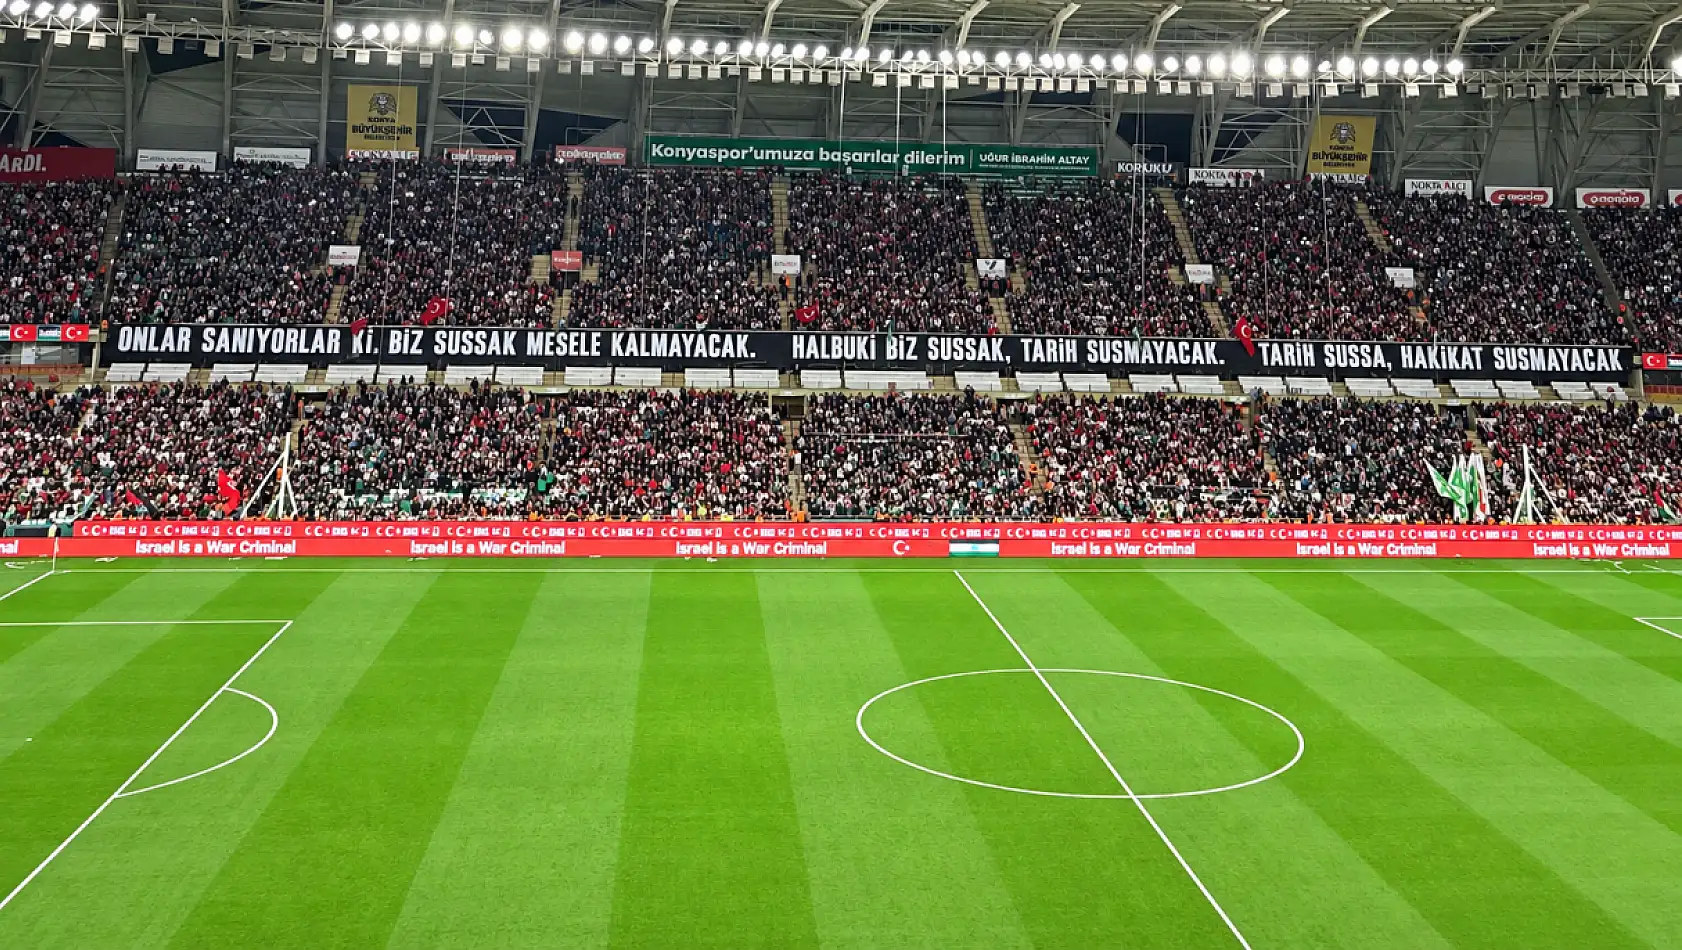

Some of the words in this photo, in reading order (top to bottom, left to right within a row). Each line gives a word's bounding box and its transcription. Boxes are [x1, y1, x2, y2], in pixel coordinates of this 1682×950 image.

[652, 143, 815, 163] Konyaspor'umuza
[819, 147, 900, 166] başarılar
[904, 150, 965, 165] dilerim
[979, 151, 1009, 163] UĞUR
[1011, 152, 1055, 164] İBRAHİM
[1058, 155, 1090, 165] ALTAY
[117, 326, 192, 353] ONLAR
[200, 327, 341, 355] SANIYORLAR
[433, 330, 517, 356] SUSSAK
[526, 331, 601, 357] MESELE
[610, 332, 756, 358] KALMAYACAK.
[927, 336, 1011, 364] SUSSAK,
[1087, 339, 1226, 365] SUSMAYACAK.
[1324, 343, 1392, 371] SUSSA,
[1493, 346, 1624, 372] SUSMAYACAK
[136, 539, 175, 554] Israel
[194, 542, 203, 554] a
[207, 539, 236, 554] War
[239, 539, 297, 554] Criminal
[410, 540, 449, 555] Israel
[466, 543, 475, 555] a
[478, 540, 507, 555] War
[510, 540, 565, 555] Criminal
[676, 541, 713, 555] Israel
[731, 544, 740, 555] a
[743, 541, 771, 555] War
[773, 541, 827, 555] Criminal
[1051, 541, 1087, 555] Israel
[1104, 544, 1112, 555] a
[1114, 541, 1141, 555] War
[1144, 541, 1196, 555] Criminal
[1296, 542, 1331, 556] Israel
[1347, 545, 1356, 556] a
[1357, 542, 1384, 556] War
[1387, 542, 1437, 556] Criminal
[1533, 543, 1567, 557] Israel
[1583, 546, 1590, 557] a
[1592, 543, 1618, 557] War
[1621, 543, 1670, 557] Criminal
